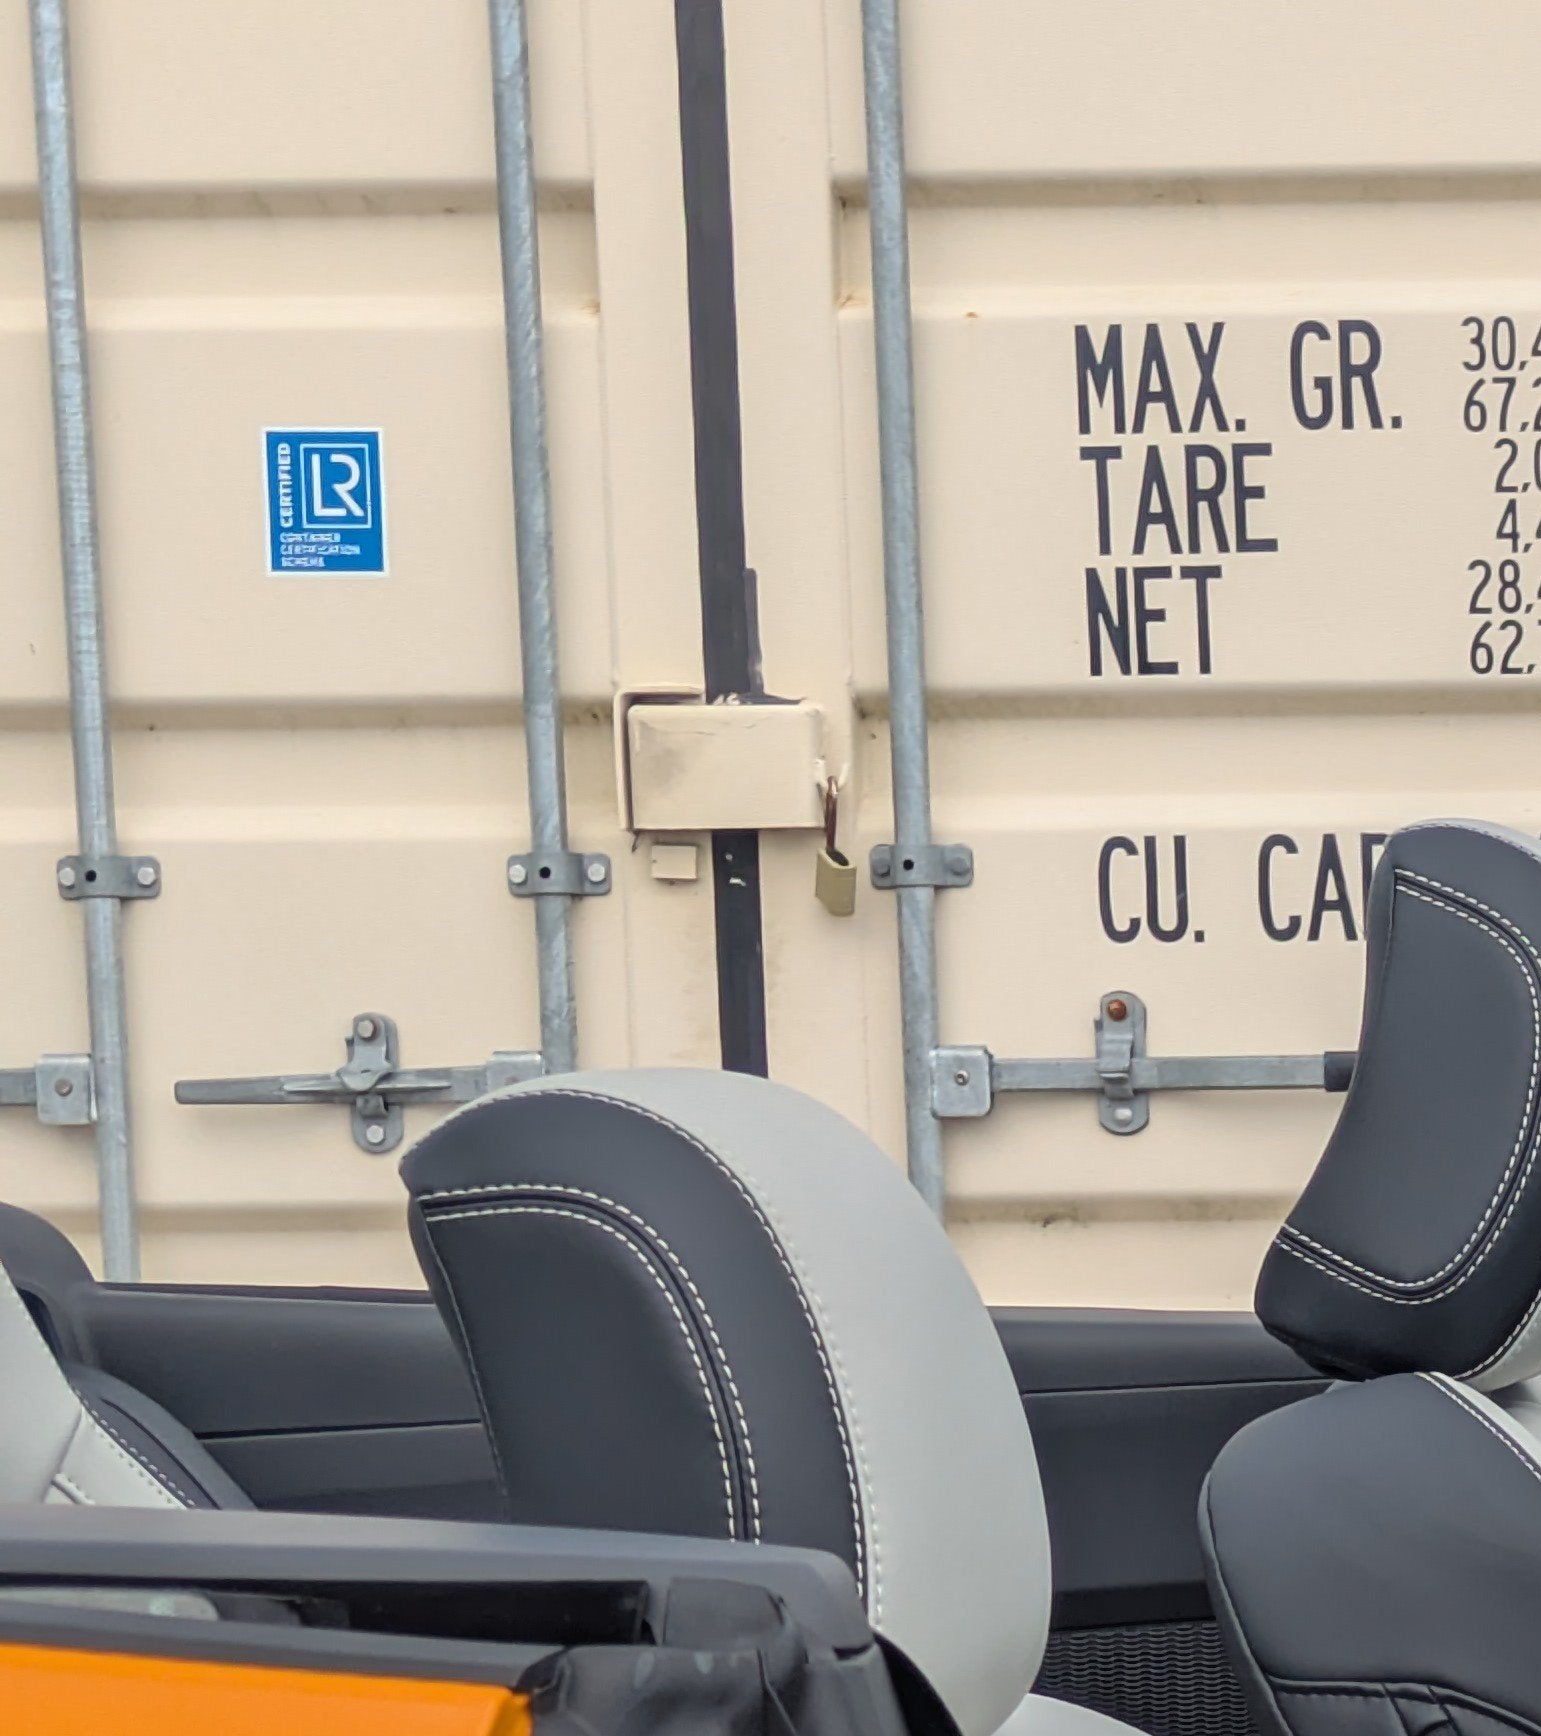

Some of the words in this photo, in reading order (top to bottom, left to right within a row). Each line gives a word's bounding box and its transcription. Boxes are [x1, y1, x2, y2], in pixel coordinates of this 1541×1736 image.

[1074, 321, 1246, 435] MAX.
[1290, 319, 1402, 431] GR.
[277, 442, 293, 528] CERTIFIED
[311, 453, 365, 517] LR
[1079, 442, 1279, 556] TARE
[1085, 565, 1222, 677] NET
[1098, 835, 1205, 944] CU.
